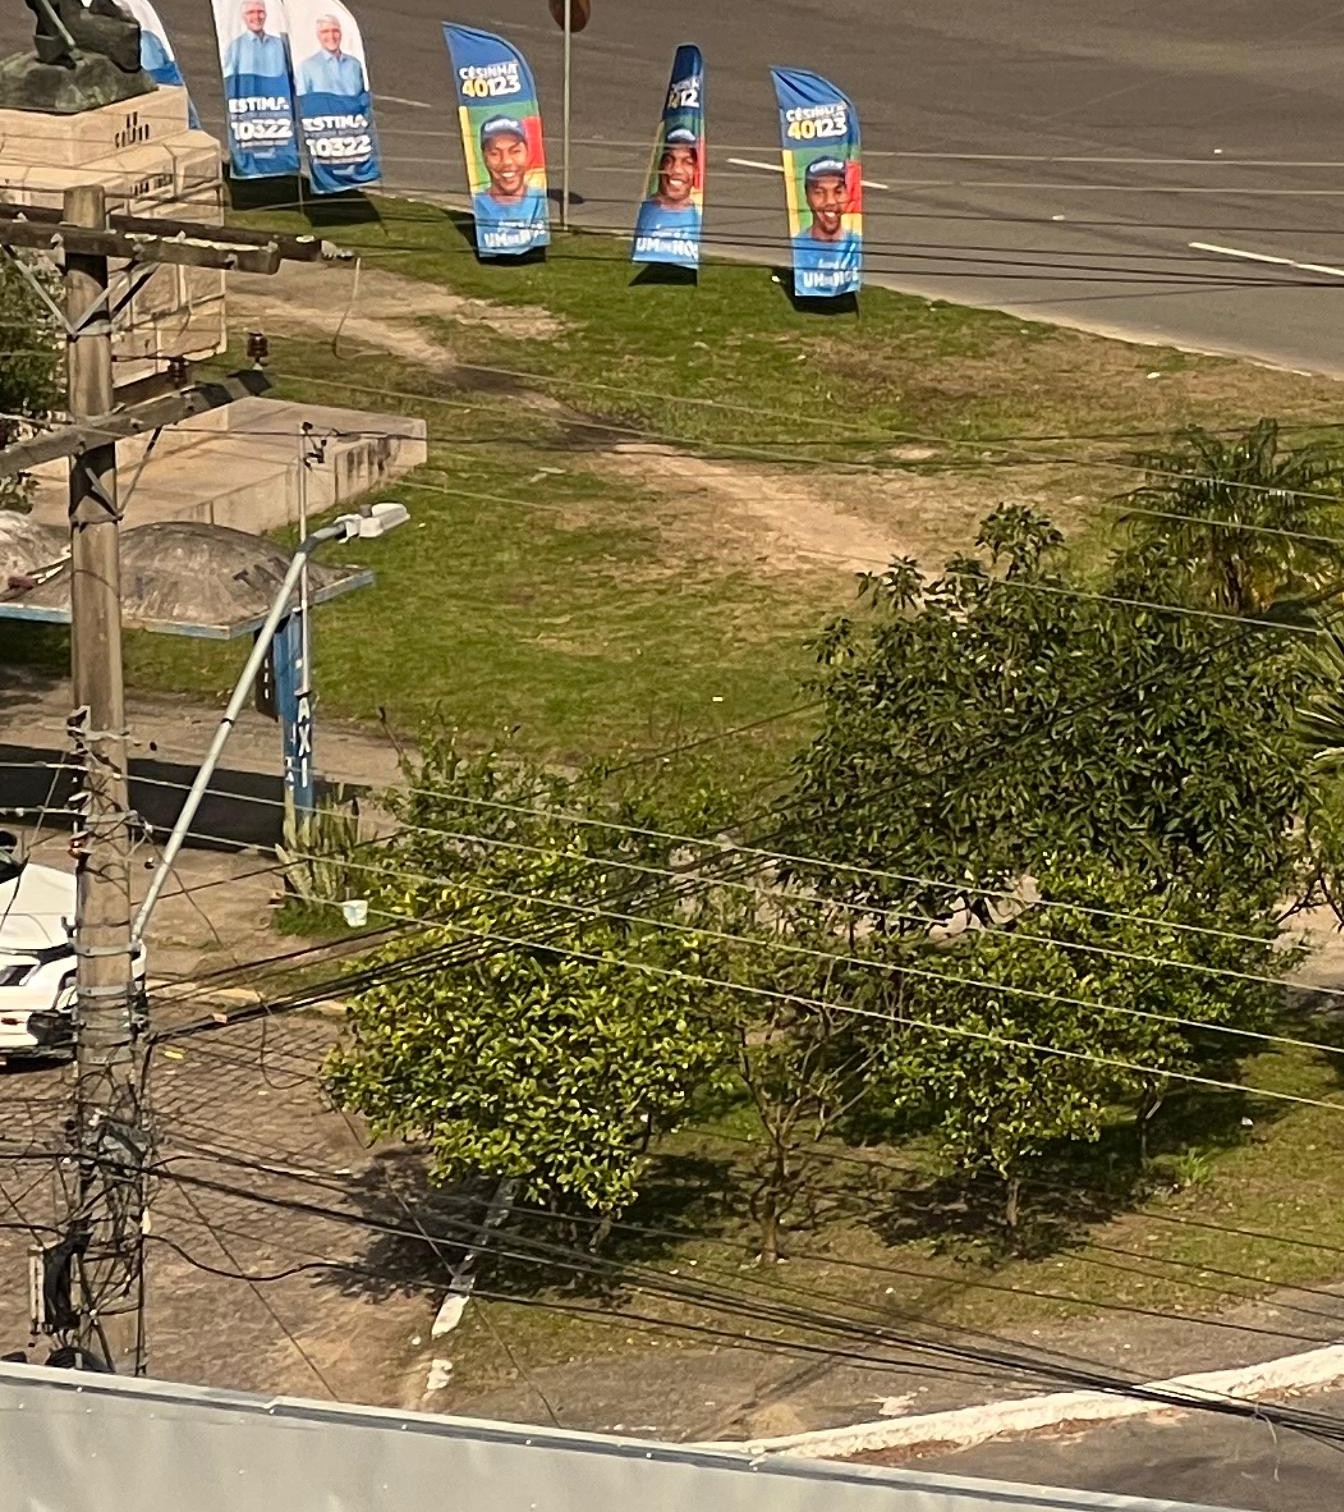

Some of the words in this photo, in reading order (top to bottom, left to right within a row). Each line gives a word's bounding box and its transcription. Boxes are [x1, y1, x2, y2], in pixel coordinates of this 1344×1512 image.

[462, 75, 521, 98] 40123
[229, 96, 289, 113] ESTIMA
[301, 113, 368, 131] ESTIMA
[787, 114, 847, 140] 40123
[306, 134, 372, 156] 10322
[297, 683, 311, 788] AXI
